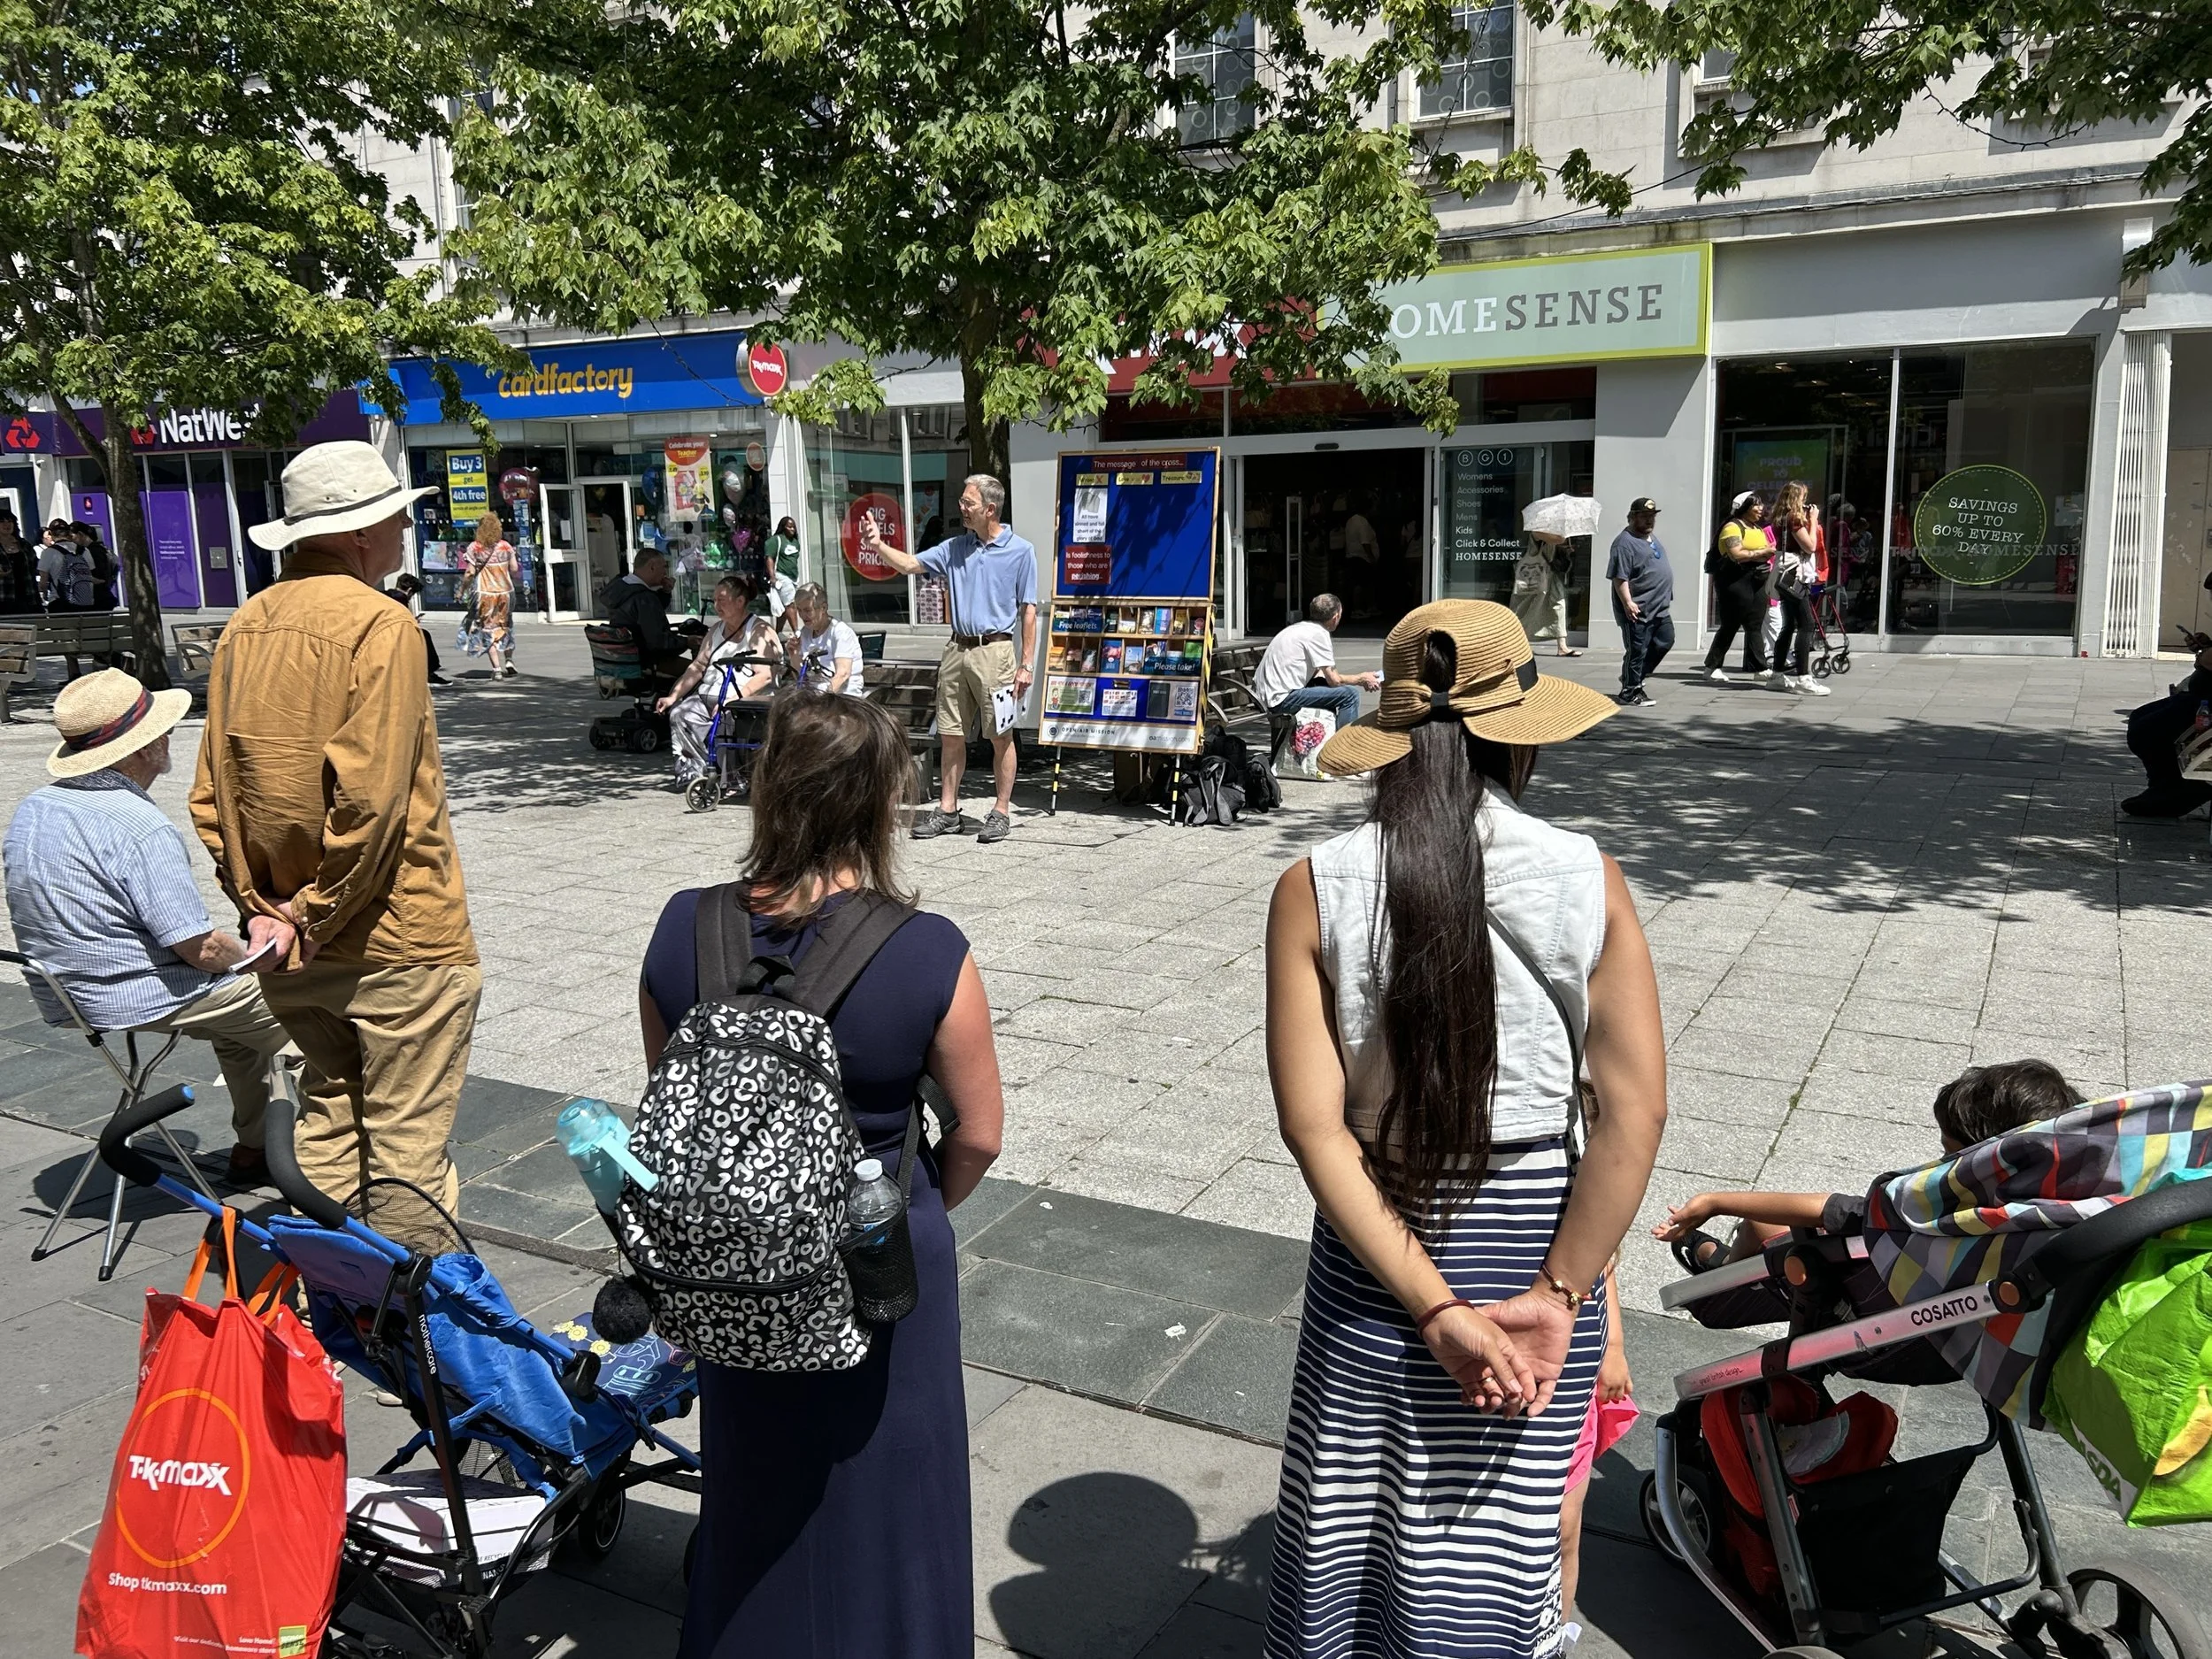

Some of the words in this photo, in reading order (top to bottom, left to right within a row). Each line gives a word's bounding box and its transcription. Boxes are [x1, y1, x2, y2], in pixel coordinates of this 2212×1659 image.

[1386, 284, 1663, 340] OMESENSE
[498, 363, 634, 398] cardfactory
[159, 403, 261, 444] NatWe
[452, 457, 473, 473] Buy
[475, 457, 483, 470] 3
[1107, 461, 1136, 470] message
[1457, 472, 1494, 481] Womens
[452, 491, 467, 501] 4th
[468, 490, 486, 501] free
[1457, 486, 1504, 495] Accessories
[1456, 500, 1481, 509] Shoes
[1948, 496, 2018, 514] SAVINGS
[1957, 512, 1978, 525] UP
[1983, 515, 2004, 527] TO
[858, 521, 895, 536] LELS
[1932, 524, 1964, 538] 60%
[1968, 527, 2025, 544] EVERY
[1455, 539, 1479, 548] Click
[1479, 539, 1486, 548] &
[1487, 538, 1520, 548] Collect
[1957, 541, 1992, 555] DAY
[1455, 551, 1522, 561] HOMESENSE
[1073, 621, 1097, 630] leaflets
[1154, 662, 1176, 671] Please
[1177, 663, 1195, 672] take!
[1911, 1296, 1978, 1325] COSATTO
[419, 1314, 437, 1375] mothercare
[108, 1572, 140, 1593] Shop
[141, 1577, 227, 1595] tkmaxx.com
